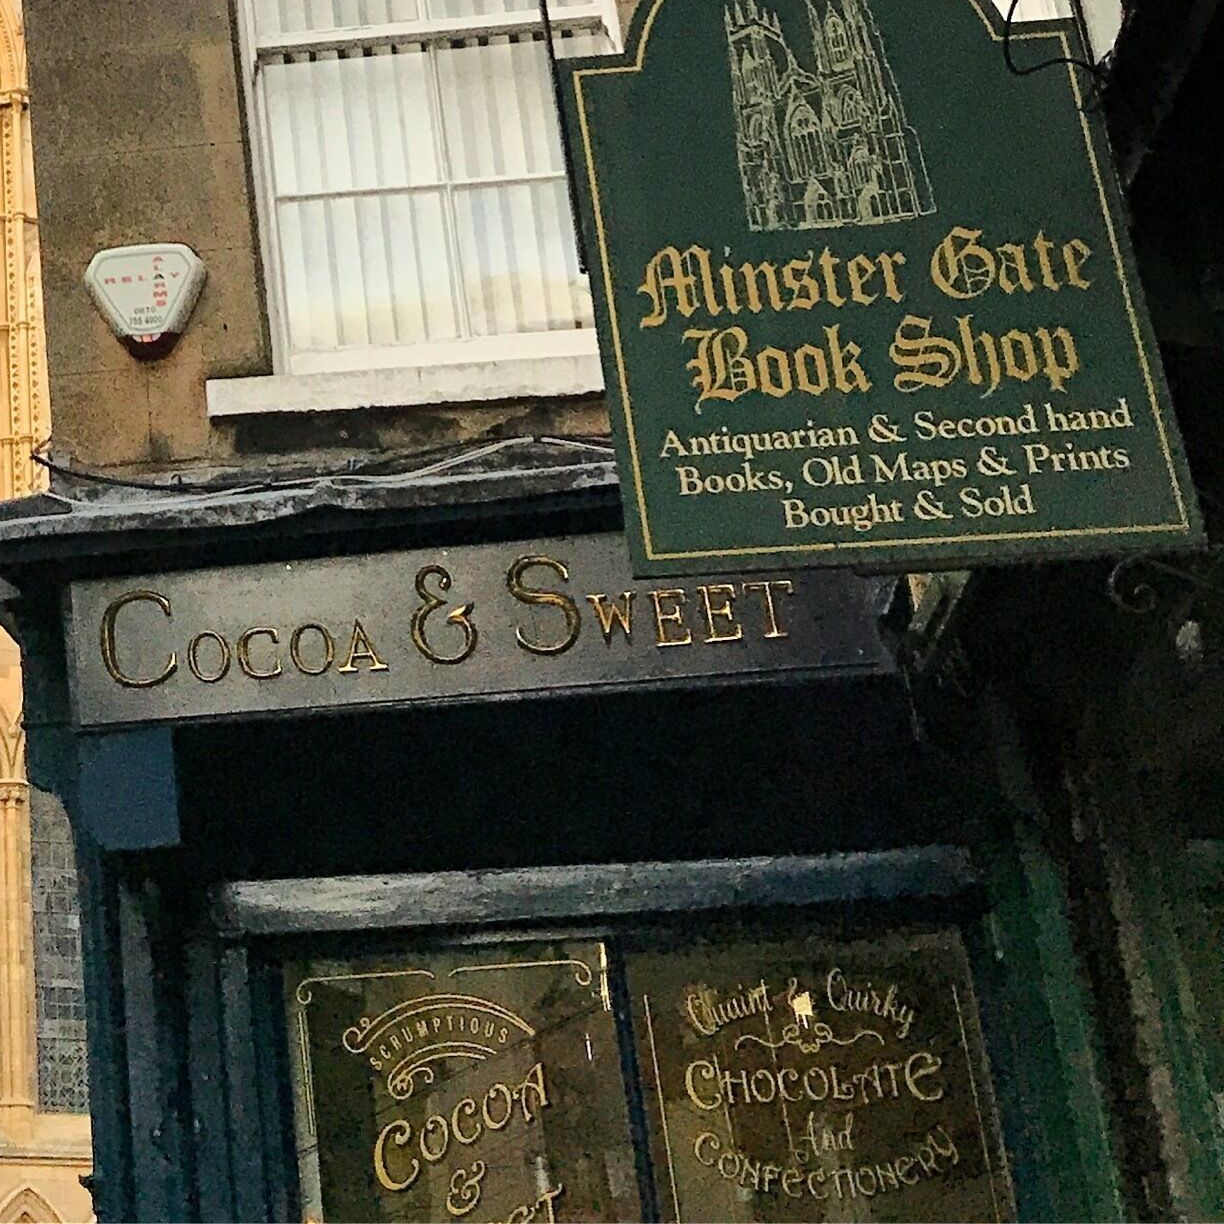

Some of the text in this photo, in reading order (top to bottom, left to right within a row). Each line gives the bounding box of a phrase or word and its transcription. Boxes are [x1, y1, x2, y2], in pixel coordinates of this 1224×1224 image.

[637, 227, 1092, 329] Minster Gate
[682, 314, 1079, 415] Book Shop
[660, 397, 1134, 460] Antiquarian & Second hand
[675, 442, 1131, 496] Books, Old Maps & Prints
[781, 483, 1037, 533] Bought & Sold
[410, 564, 476, 665] &
[687, 979, 773, 1035] Quaint
[827, 968, 913, 1039] Quirky
[369, 1014, 510, 1072] SCRUMPTIOUS
[446, 1160, 486, 1216] &
